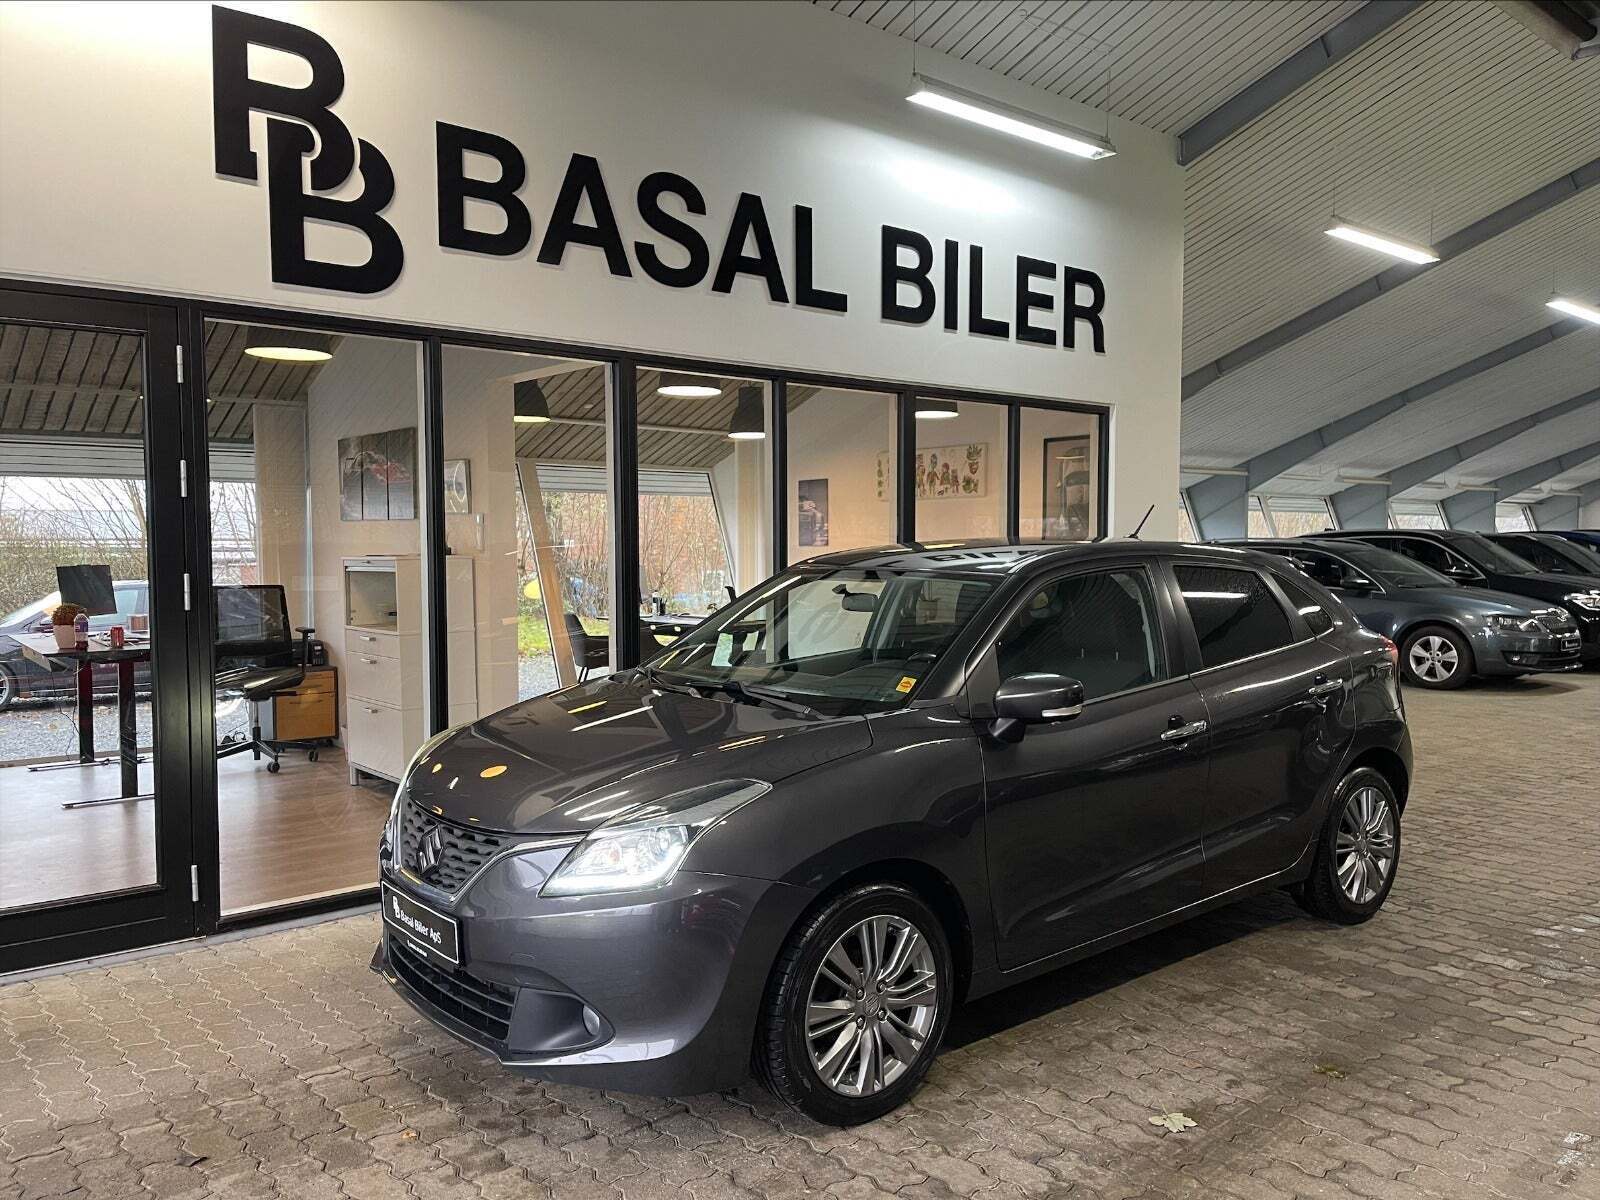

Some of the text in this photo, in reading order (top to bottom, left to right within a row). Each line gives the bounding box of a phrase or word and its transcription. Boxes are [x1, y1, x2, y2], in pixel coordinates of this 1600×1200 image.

[436, 120, 849, 314] BASAL
[881, 223, 1106, 355] BILER
[400, 909, 415, 929] Basal
[414, 919, 429, 937] Biler
[429, 927, 442, 945] ApS
